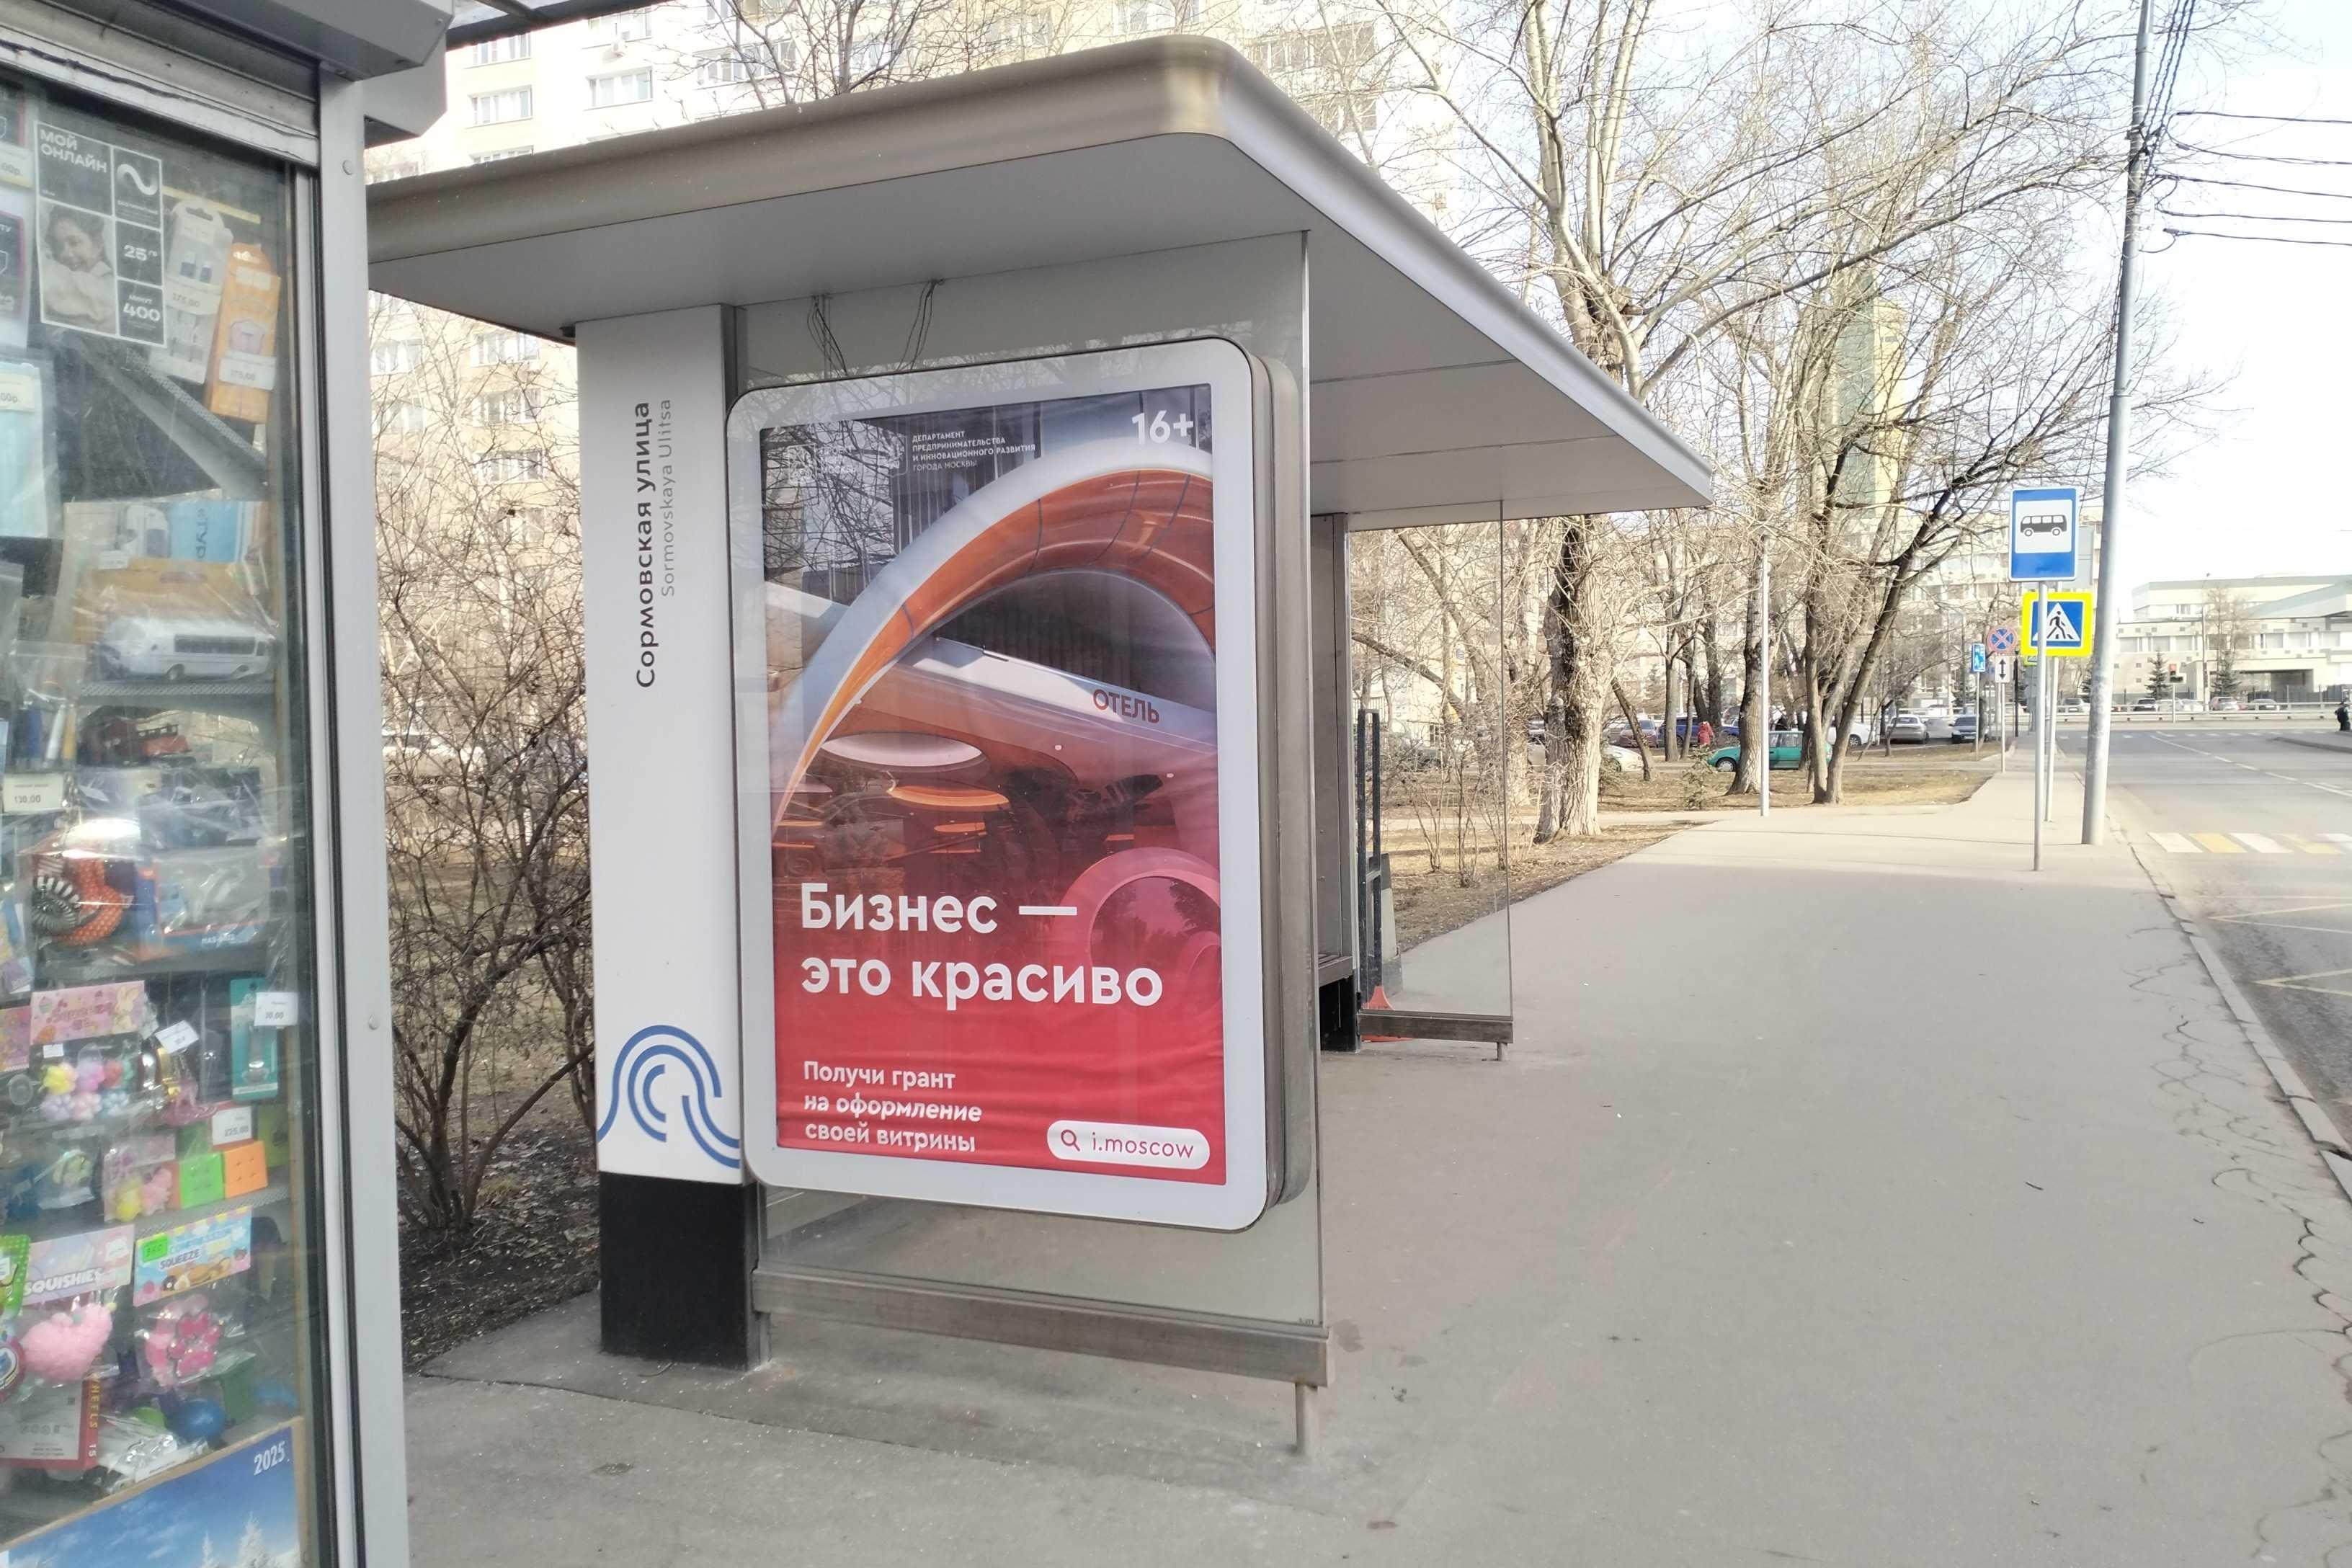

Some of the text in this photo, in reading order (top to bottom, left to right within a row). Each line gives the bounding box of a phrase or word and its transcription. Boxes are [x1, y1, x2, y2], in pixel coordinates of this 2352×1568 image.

[40, 128, 78, 151] МОЙ
[40, 143, 107, 174] ОНЛАЙН
[123, 244, 148, 262] 25
[122, 303, 161, 322] 400
[912, 430, 966, 444] ДЕПАРТАМЕНТ
[1131, 409, 1194, 445] 16+
[912, 437, 1006, 453] ПРЕДПРИНИМАТЕЛЬСТВА
[920, 448, 994, 461] ИННОВАЦИОННОГО
[996, 443, 1036, 454] РАЗВИТИЯ
[913, 460, 977, 472] ГОРОДА МОСКВЫ
[657, 398, 676, 597] Sormovskaya Ulitsa
[634, 401, 660, 688] Сормовская улица
[1092, 688, 1160, 724] ОТЕЛЬ
[801, 882, 998, 935] Бизнес
[801, 956, 1164, 1011] это красиво
[803, 1060, 956, 1091] Получи грант
[803, 1092, 983, 1123] на оформление
[805, 1121, 976, 1153] своей витрины
[1091, 1131, 1195, 1159] i.moscow
[159, 1248, 201, 1270] SQUEEZE
